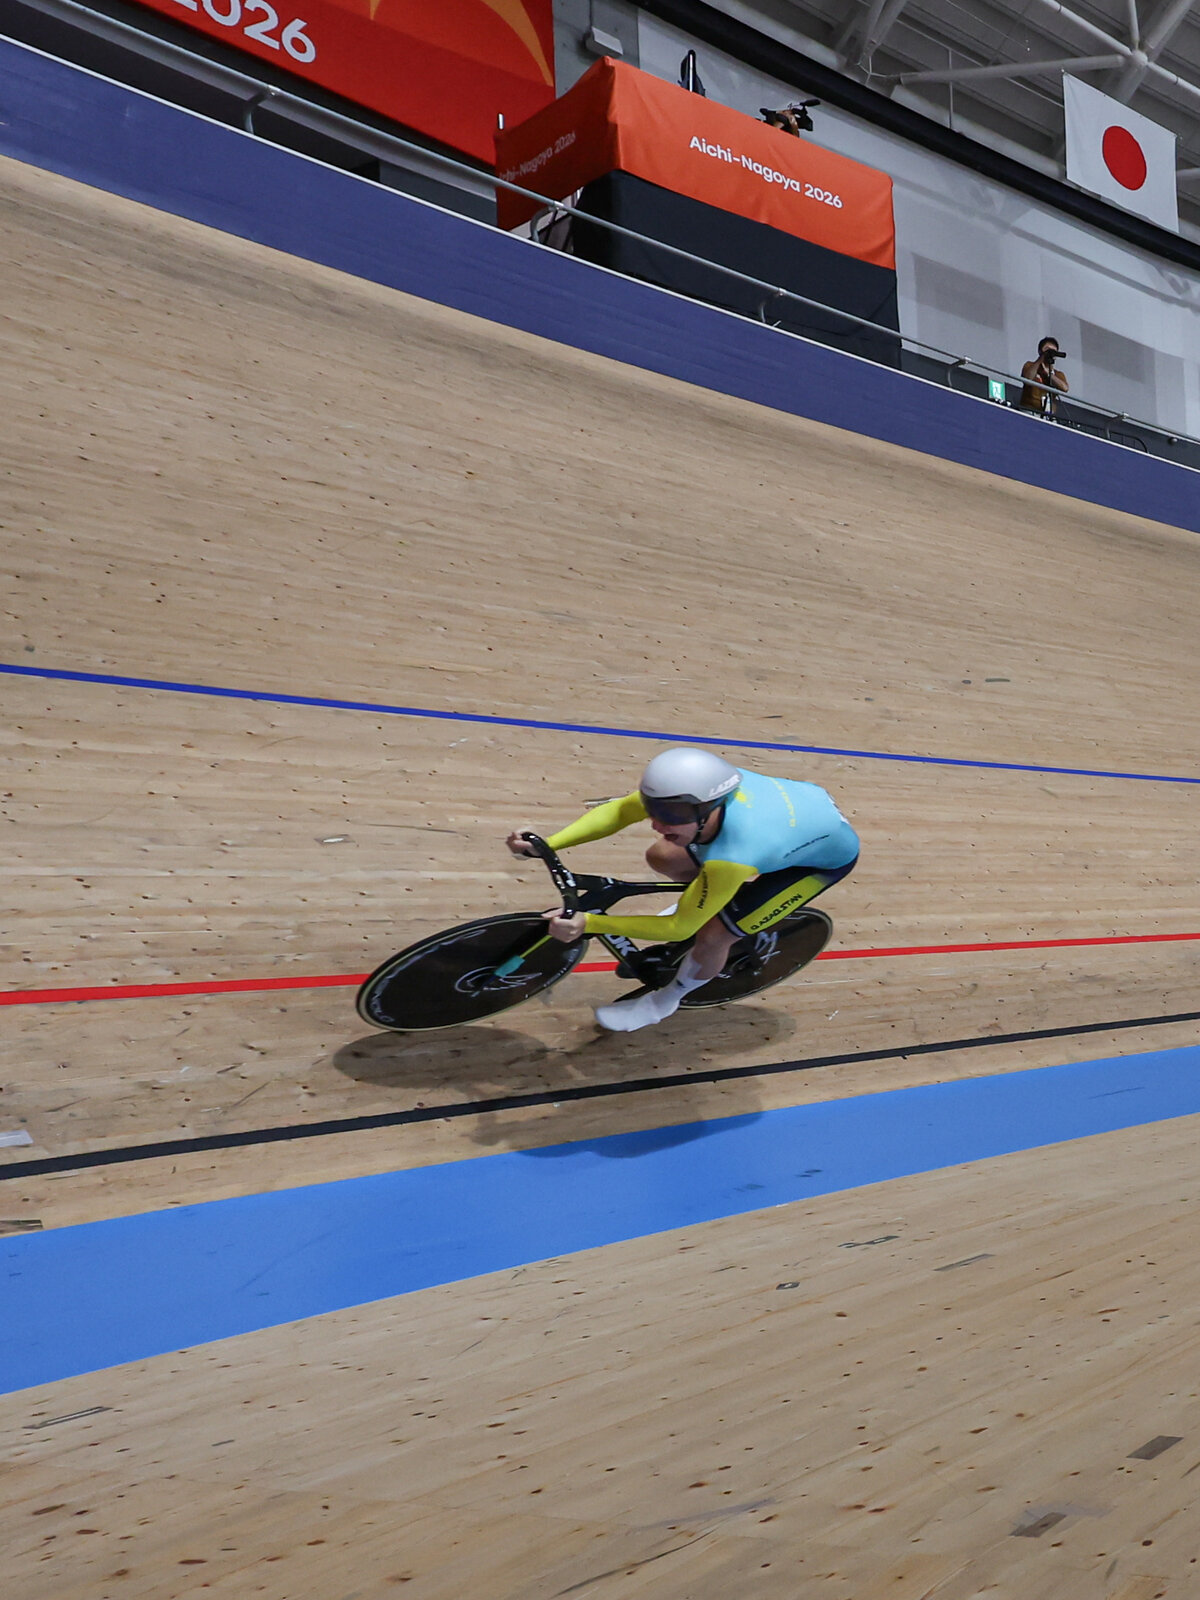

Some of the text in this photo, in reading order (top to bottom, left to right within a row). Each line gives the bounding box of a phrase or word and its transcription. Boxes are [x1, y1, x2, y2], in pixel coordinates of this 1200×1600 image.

[173, 0, 316, 63] 026
[500, 147, 553, 181] ichi-Nagoya
[690, 136, 844, 209] Aichi-Nagoya 2026
